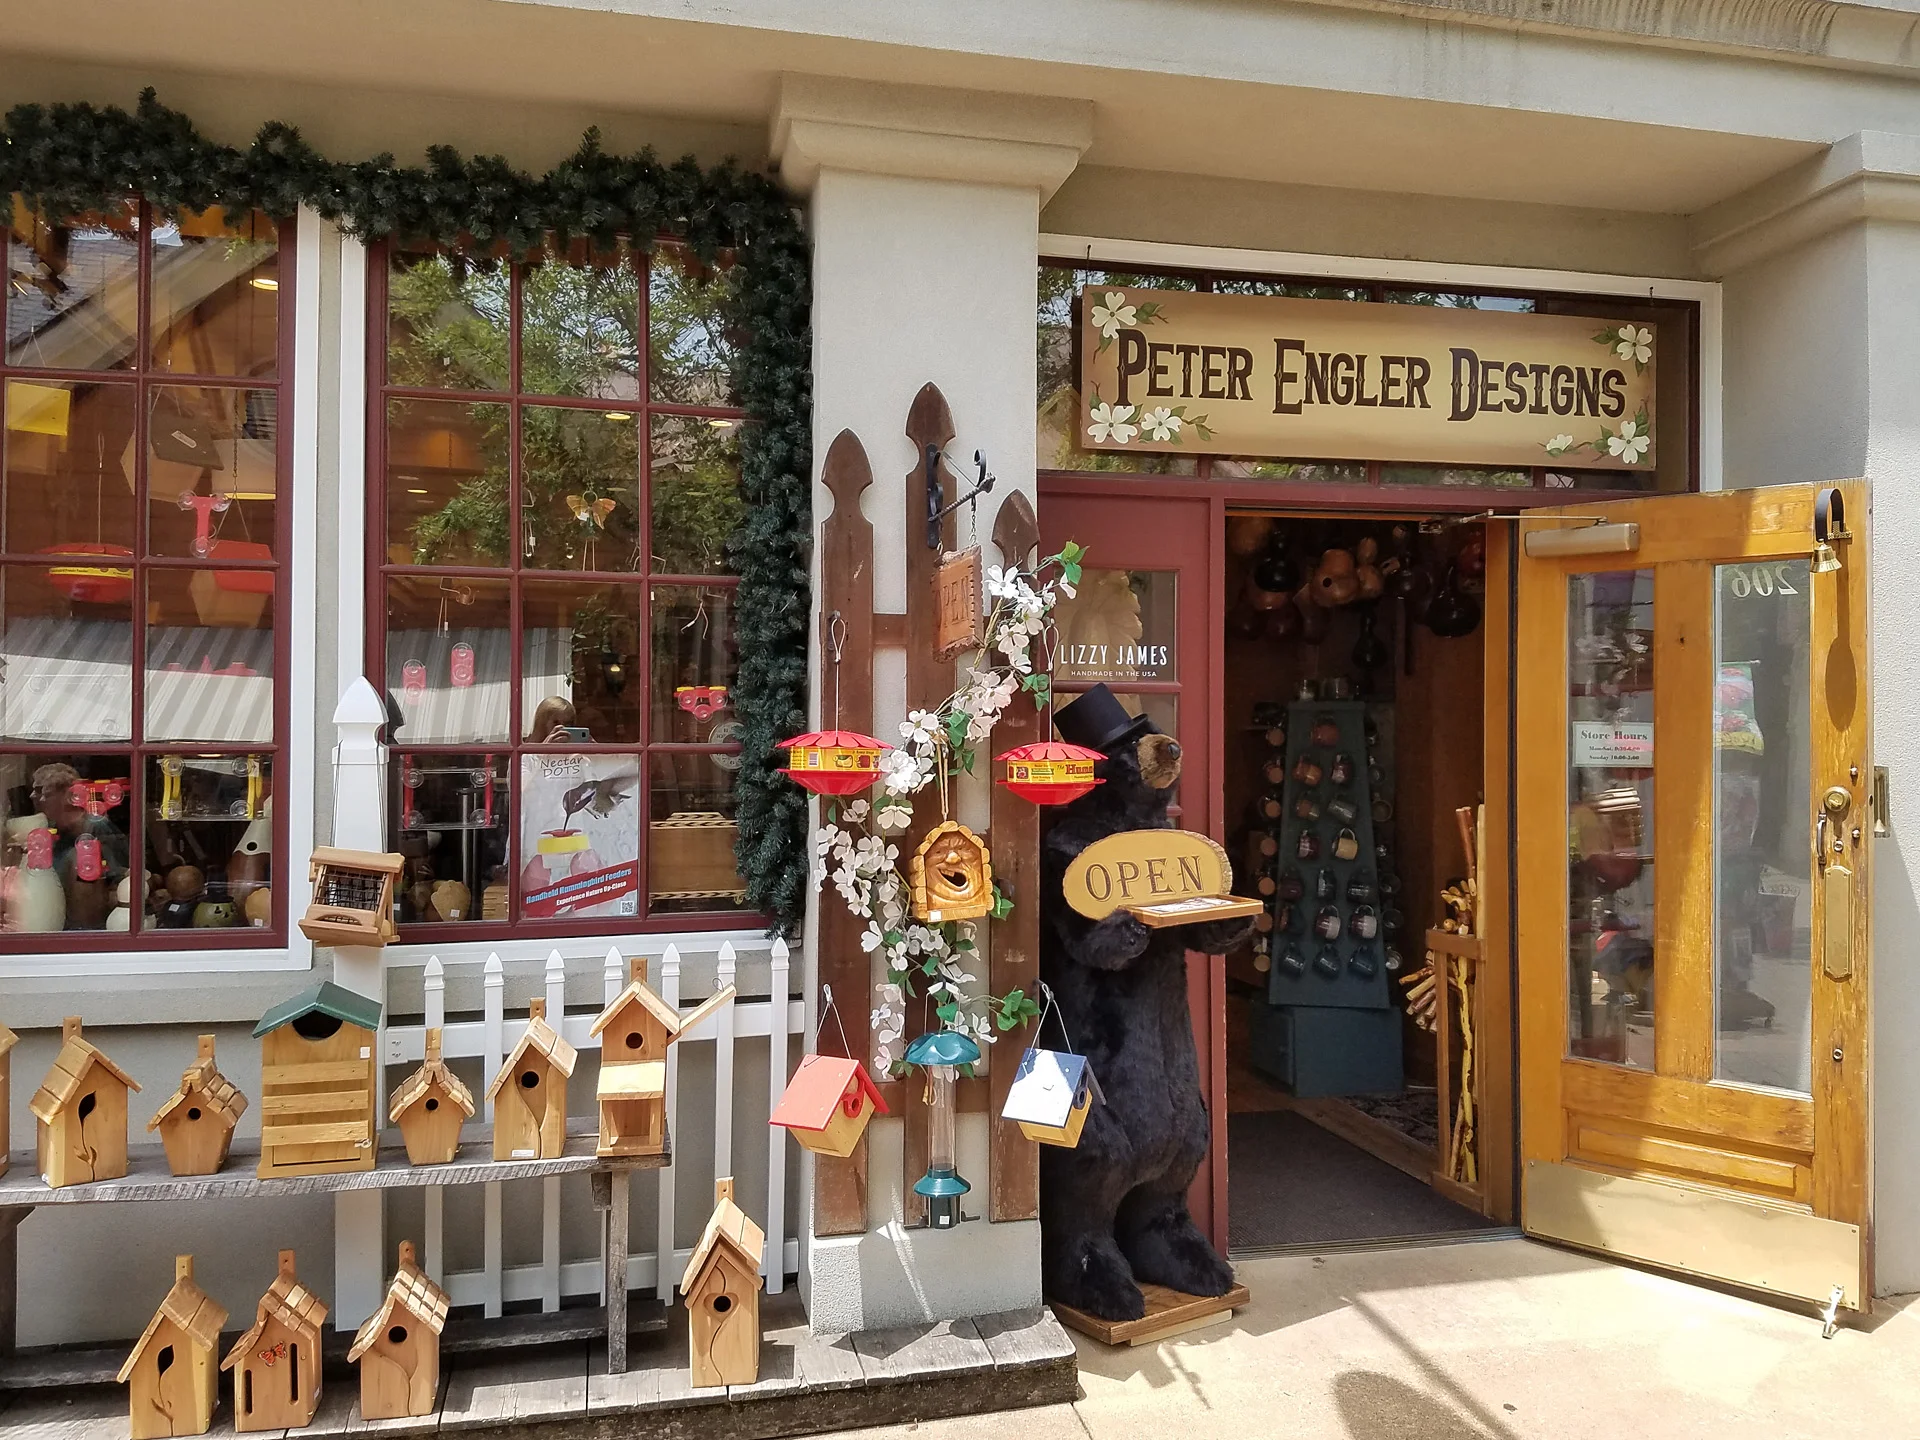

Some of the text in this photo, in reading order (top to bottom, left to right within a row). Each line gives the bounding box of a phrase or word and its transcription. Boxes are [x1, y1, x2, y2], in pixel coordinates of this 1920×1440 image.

[1114, 328, 1628, 422] PETER ENGLER DESIGNS
[1060, 644, 1168, 666] LIZZY JAMES
[1581, 729, 1648, 740] Store Hours
[540, 756, 583, 769] Nectar
[543, 765, 580, 778] DOTS
[1085, 855, 1204, 901] OPEN
